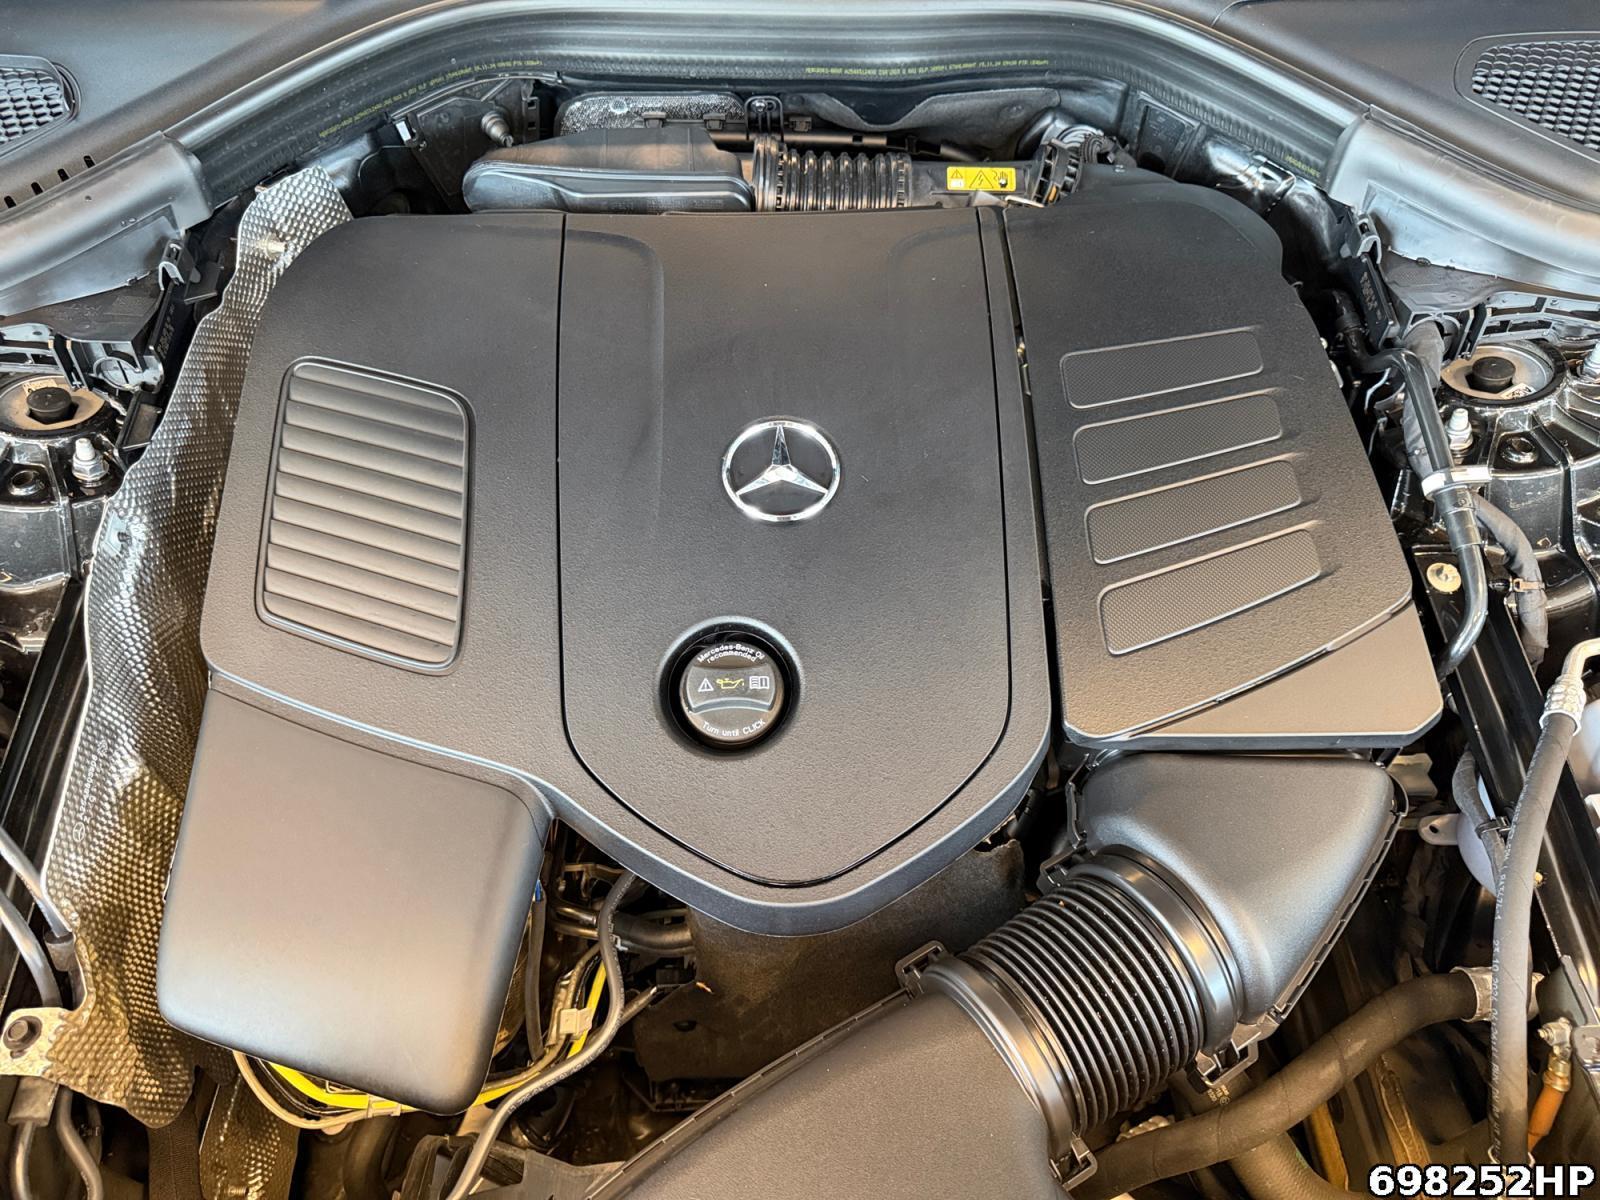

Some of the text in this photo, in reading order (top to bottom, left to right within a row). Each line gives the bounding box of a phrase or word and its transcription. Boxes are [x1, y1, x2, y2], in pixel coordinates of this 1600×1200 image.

[697, 643, 765, 663] Mercedes-Benz Oil
[707, 649, 757, 664] recommended
[702, 718, 766, 737] Turn until CLICK
